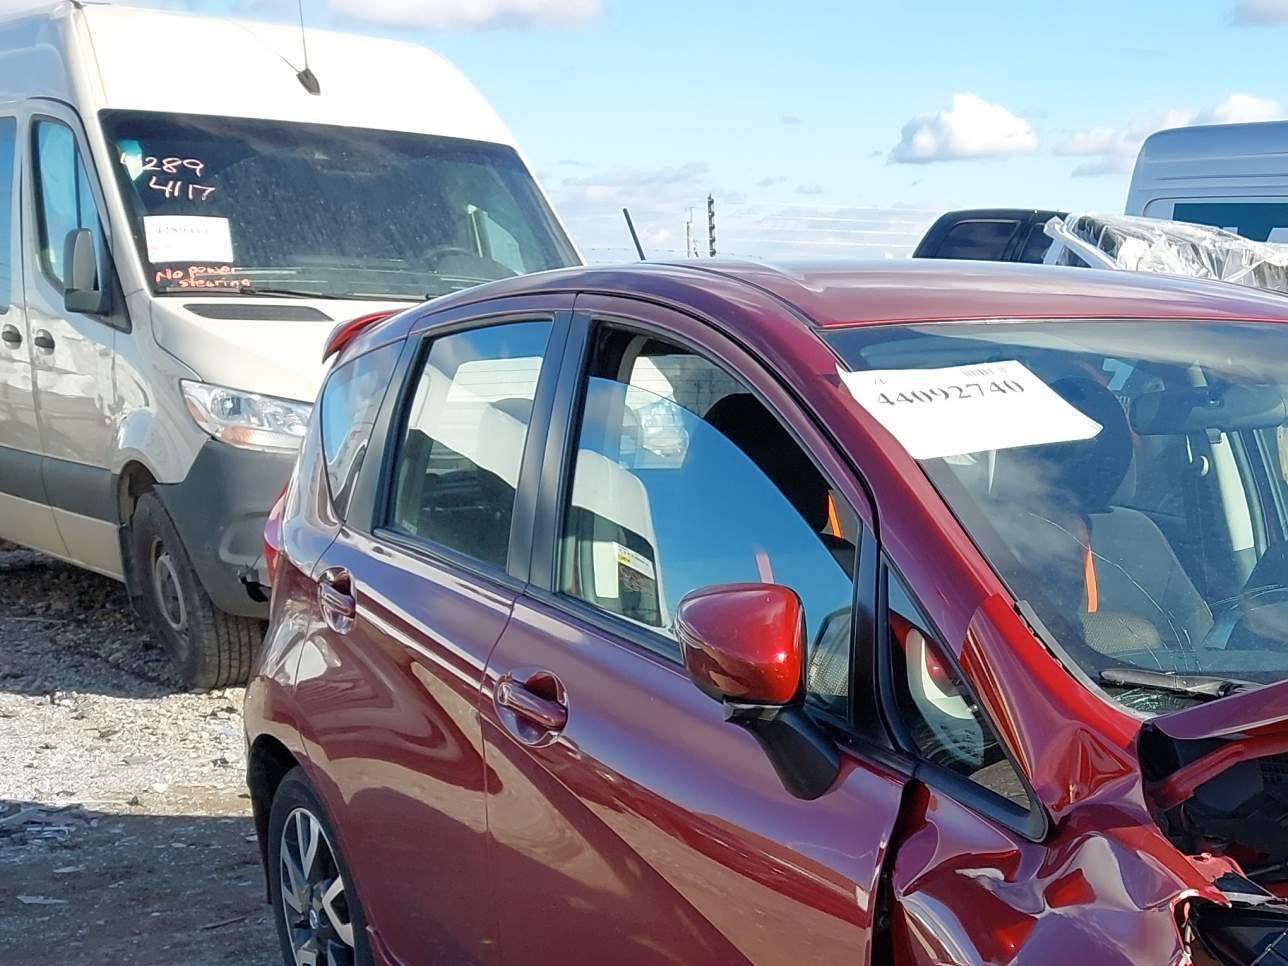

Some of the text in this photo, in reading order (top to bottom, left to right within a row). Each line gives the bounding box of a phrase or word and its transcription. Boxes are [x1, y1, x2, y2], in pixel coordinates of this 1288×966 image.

[149, 176, 216, 200] 4117
[156, 265, 240, 282] No power
[877, 379, 1025, 406] 44092740
